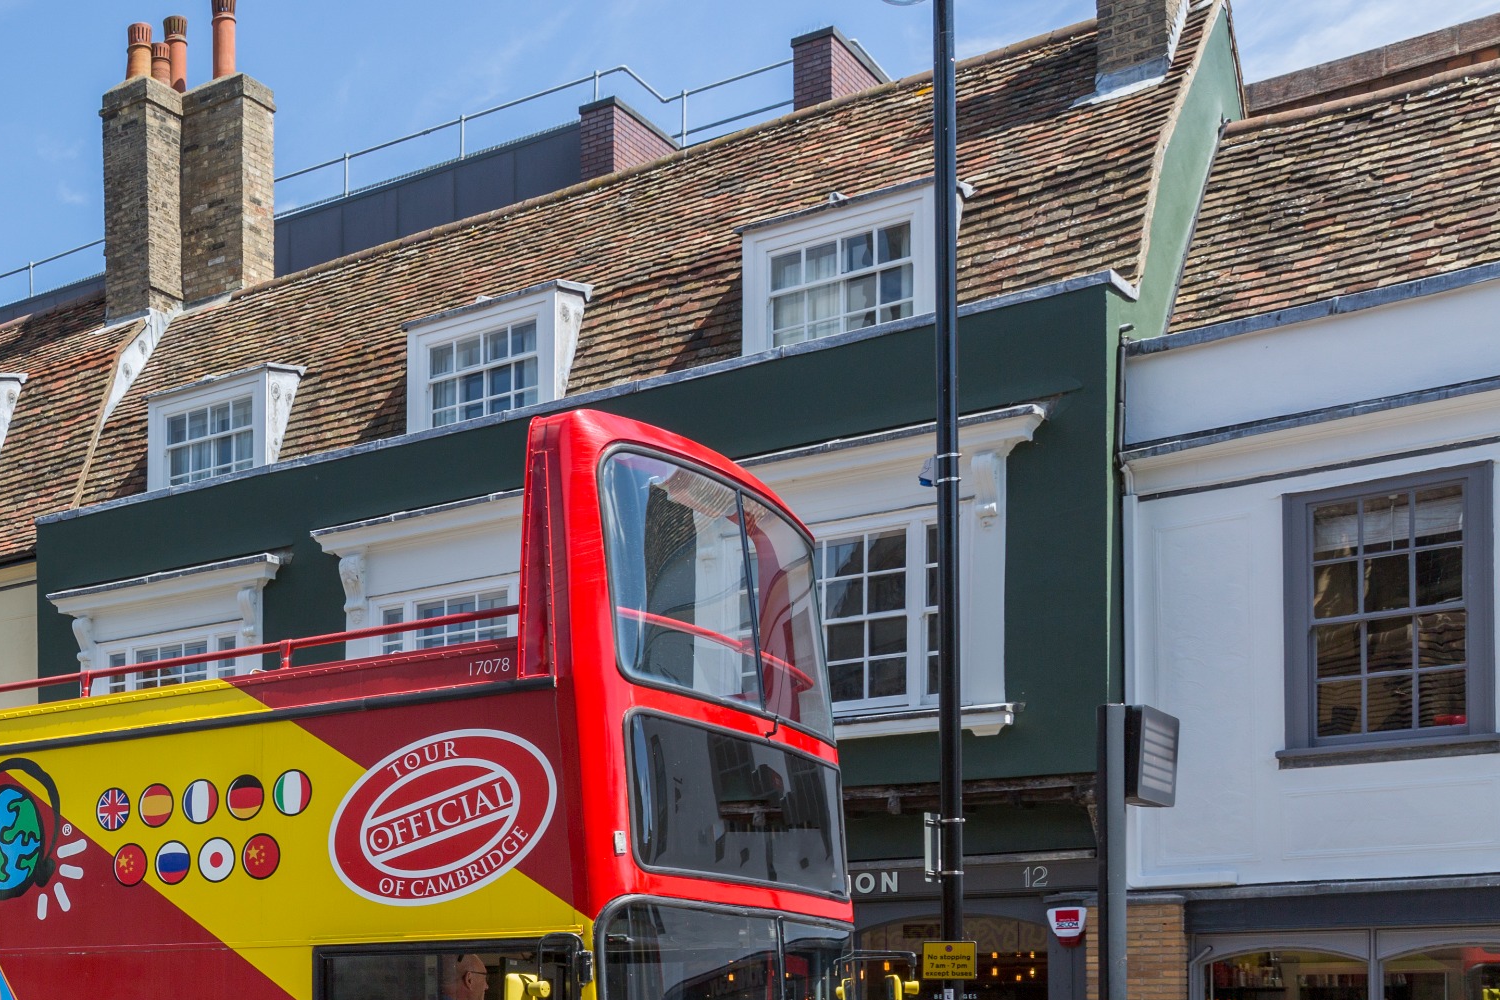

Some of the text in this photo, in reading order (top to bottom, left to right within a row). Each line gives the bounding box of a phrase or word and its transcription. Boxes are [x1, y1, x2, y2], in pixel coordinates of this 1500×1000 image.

[469, 657, 510, 676] 17078
[386, 740, 459, 779] TOUR
[369, 782, 514, 852] OFFICIAL
[378, 825, 529, 897] OF CAMBRIDGE
[1022, 866, 1048, 888] 12
